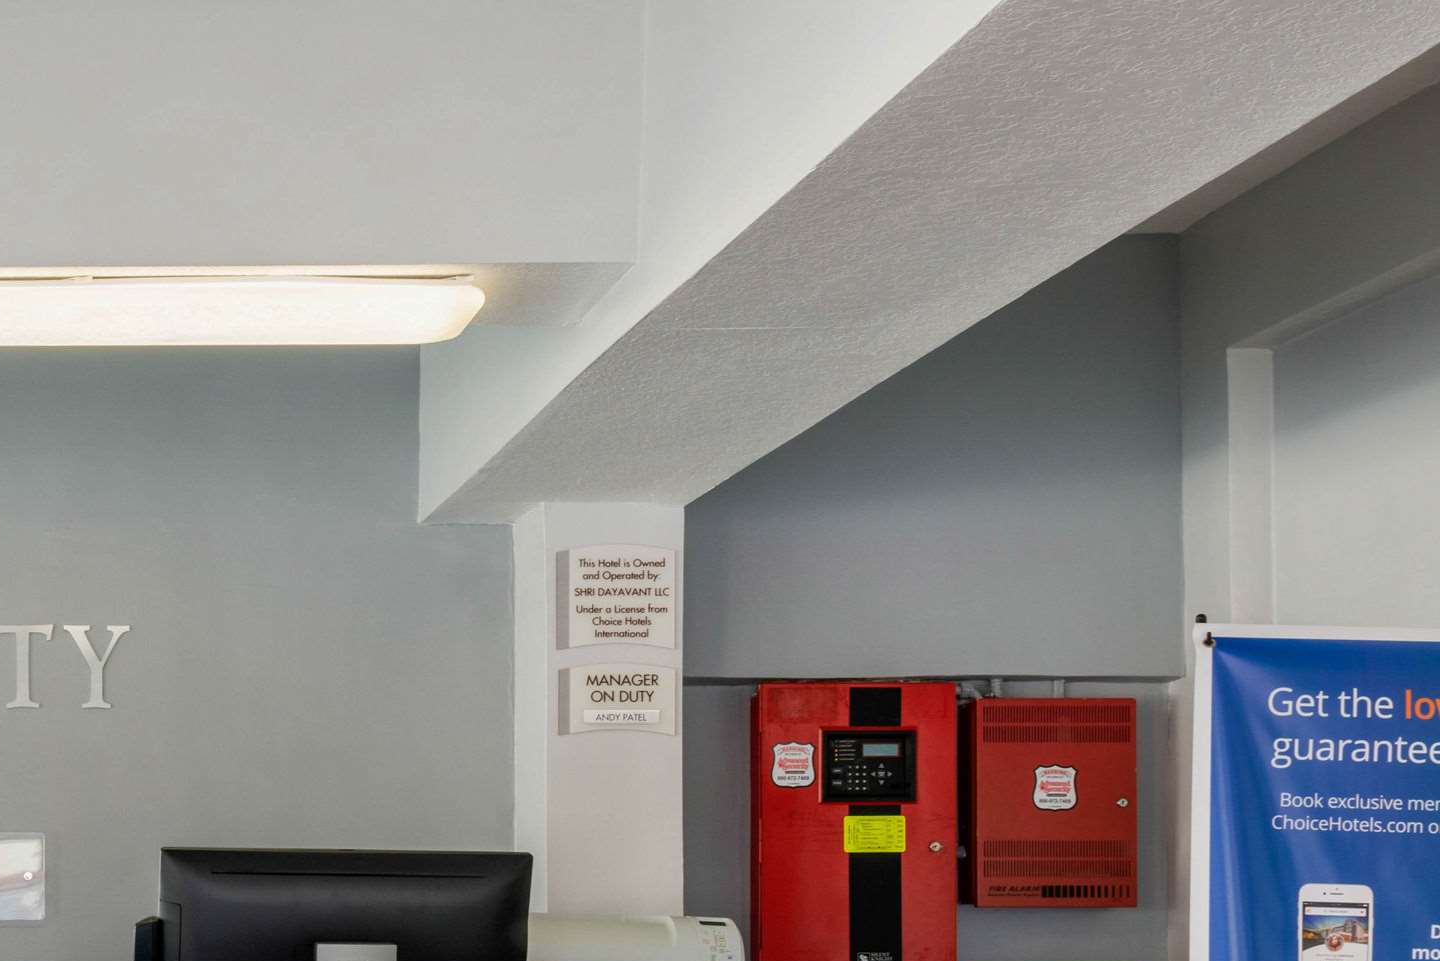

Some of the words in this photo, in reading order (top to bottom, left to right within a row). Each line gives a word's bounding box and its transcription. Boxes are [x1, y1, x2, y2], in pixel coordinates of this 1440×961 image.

[579, 558, 596, 568] This
[598, 558, 620, 568] Hotel
[623, 558, 631, 568] is
[633, 558, 666, 568] Owned
[582, 570, 600, 580] and
[602, 570, 644, 582] Operated
[574, 587, 595, 596] SHRI
[598, 587, 652, 596] DAYAVANT
[654, 587, 670, 596] LLC
[576, 603, 603, 614] Under
[614, 604, 646, 614] License
[648, 603, 668, 613] from
[592, 615, 622, 626] Choice
[625, 616, 652, 626] Hotels
[594, 628, 649, 638] International
[586, 674, 659, 686] MANAGER
[590, 690, 615, 703] ON
[619, 690, 655, 703] DUTY
[1267, 687, 1329, 717] Get
[1338, 688, 1394, 719] the
[1404, 688, 1440, 720] lo
[595, 713, 620, 721] ANDY
[623, 713, 647, 721] PATEL
[1280, 792, 1324, 808] Book
[1328, 794, 1404, 811] exclusive
[1271, 815, 1424, 834] ChoiceHotels.com
